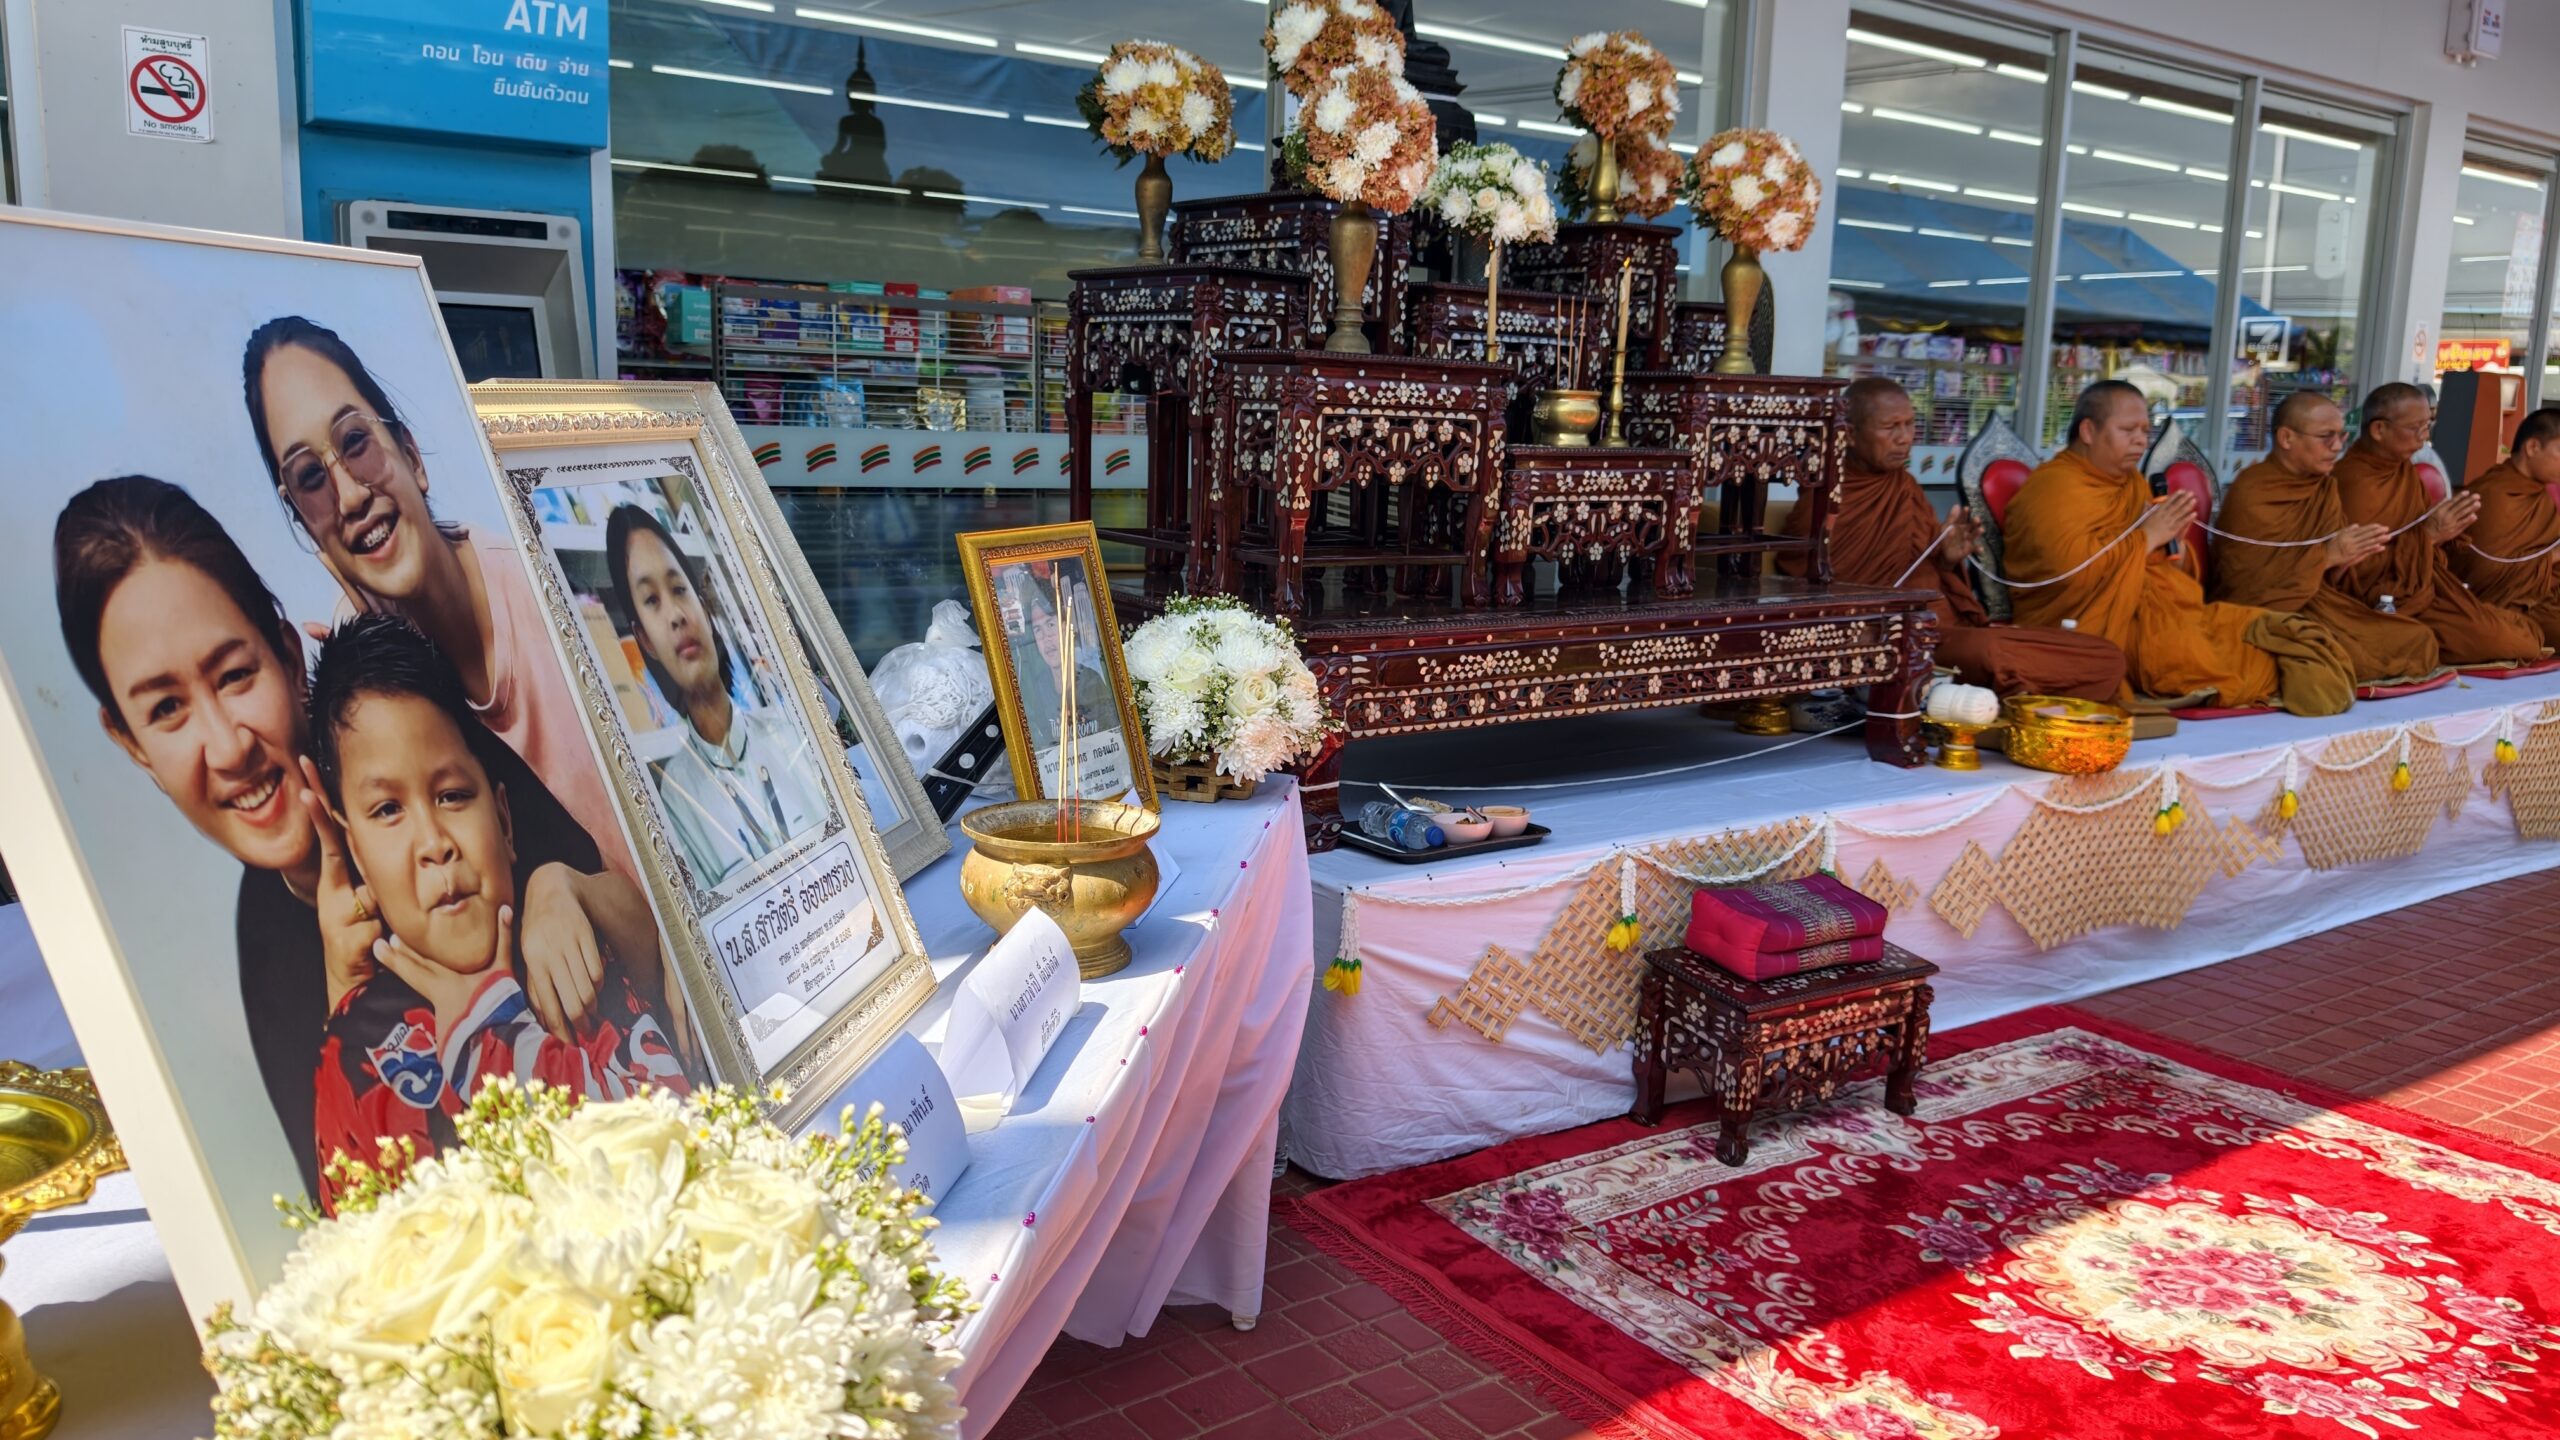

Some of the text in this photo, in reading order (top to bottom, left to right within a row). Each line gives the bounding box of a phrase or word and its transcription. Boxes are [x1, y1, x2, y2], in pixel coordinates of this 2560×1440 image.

[504, 0, 588, 41] ATM
[422, 44, 590, 77] ถอน โอน เติม จ่าย
[493, 77, 590, 105] ยืนยันตัวตน
[143, 119, 157, 129] No
